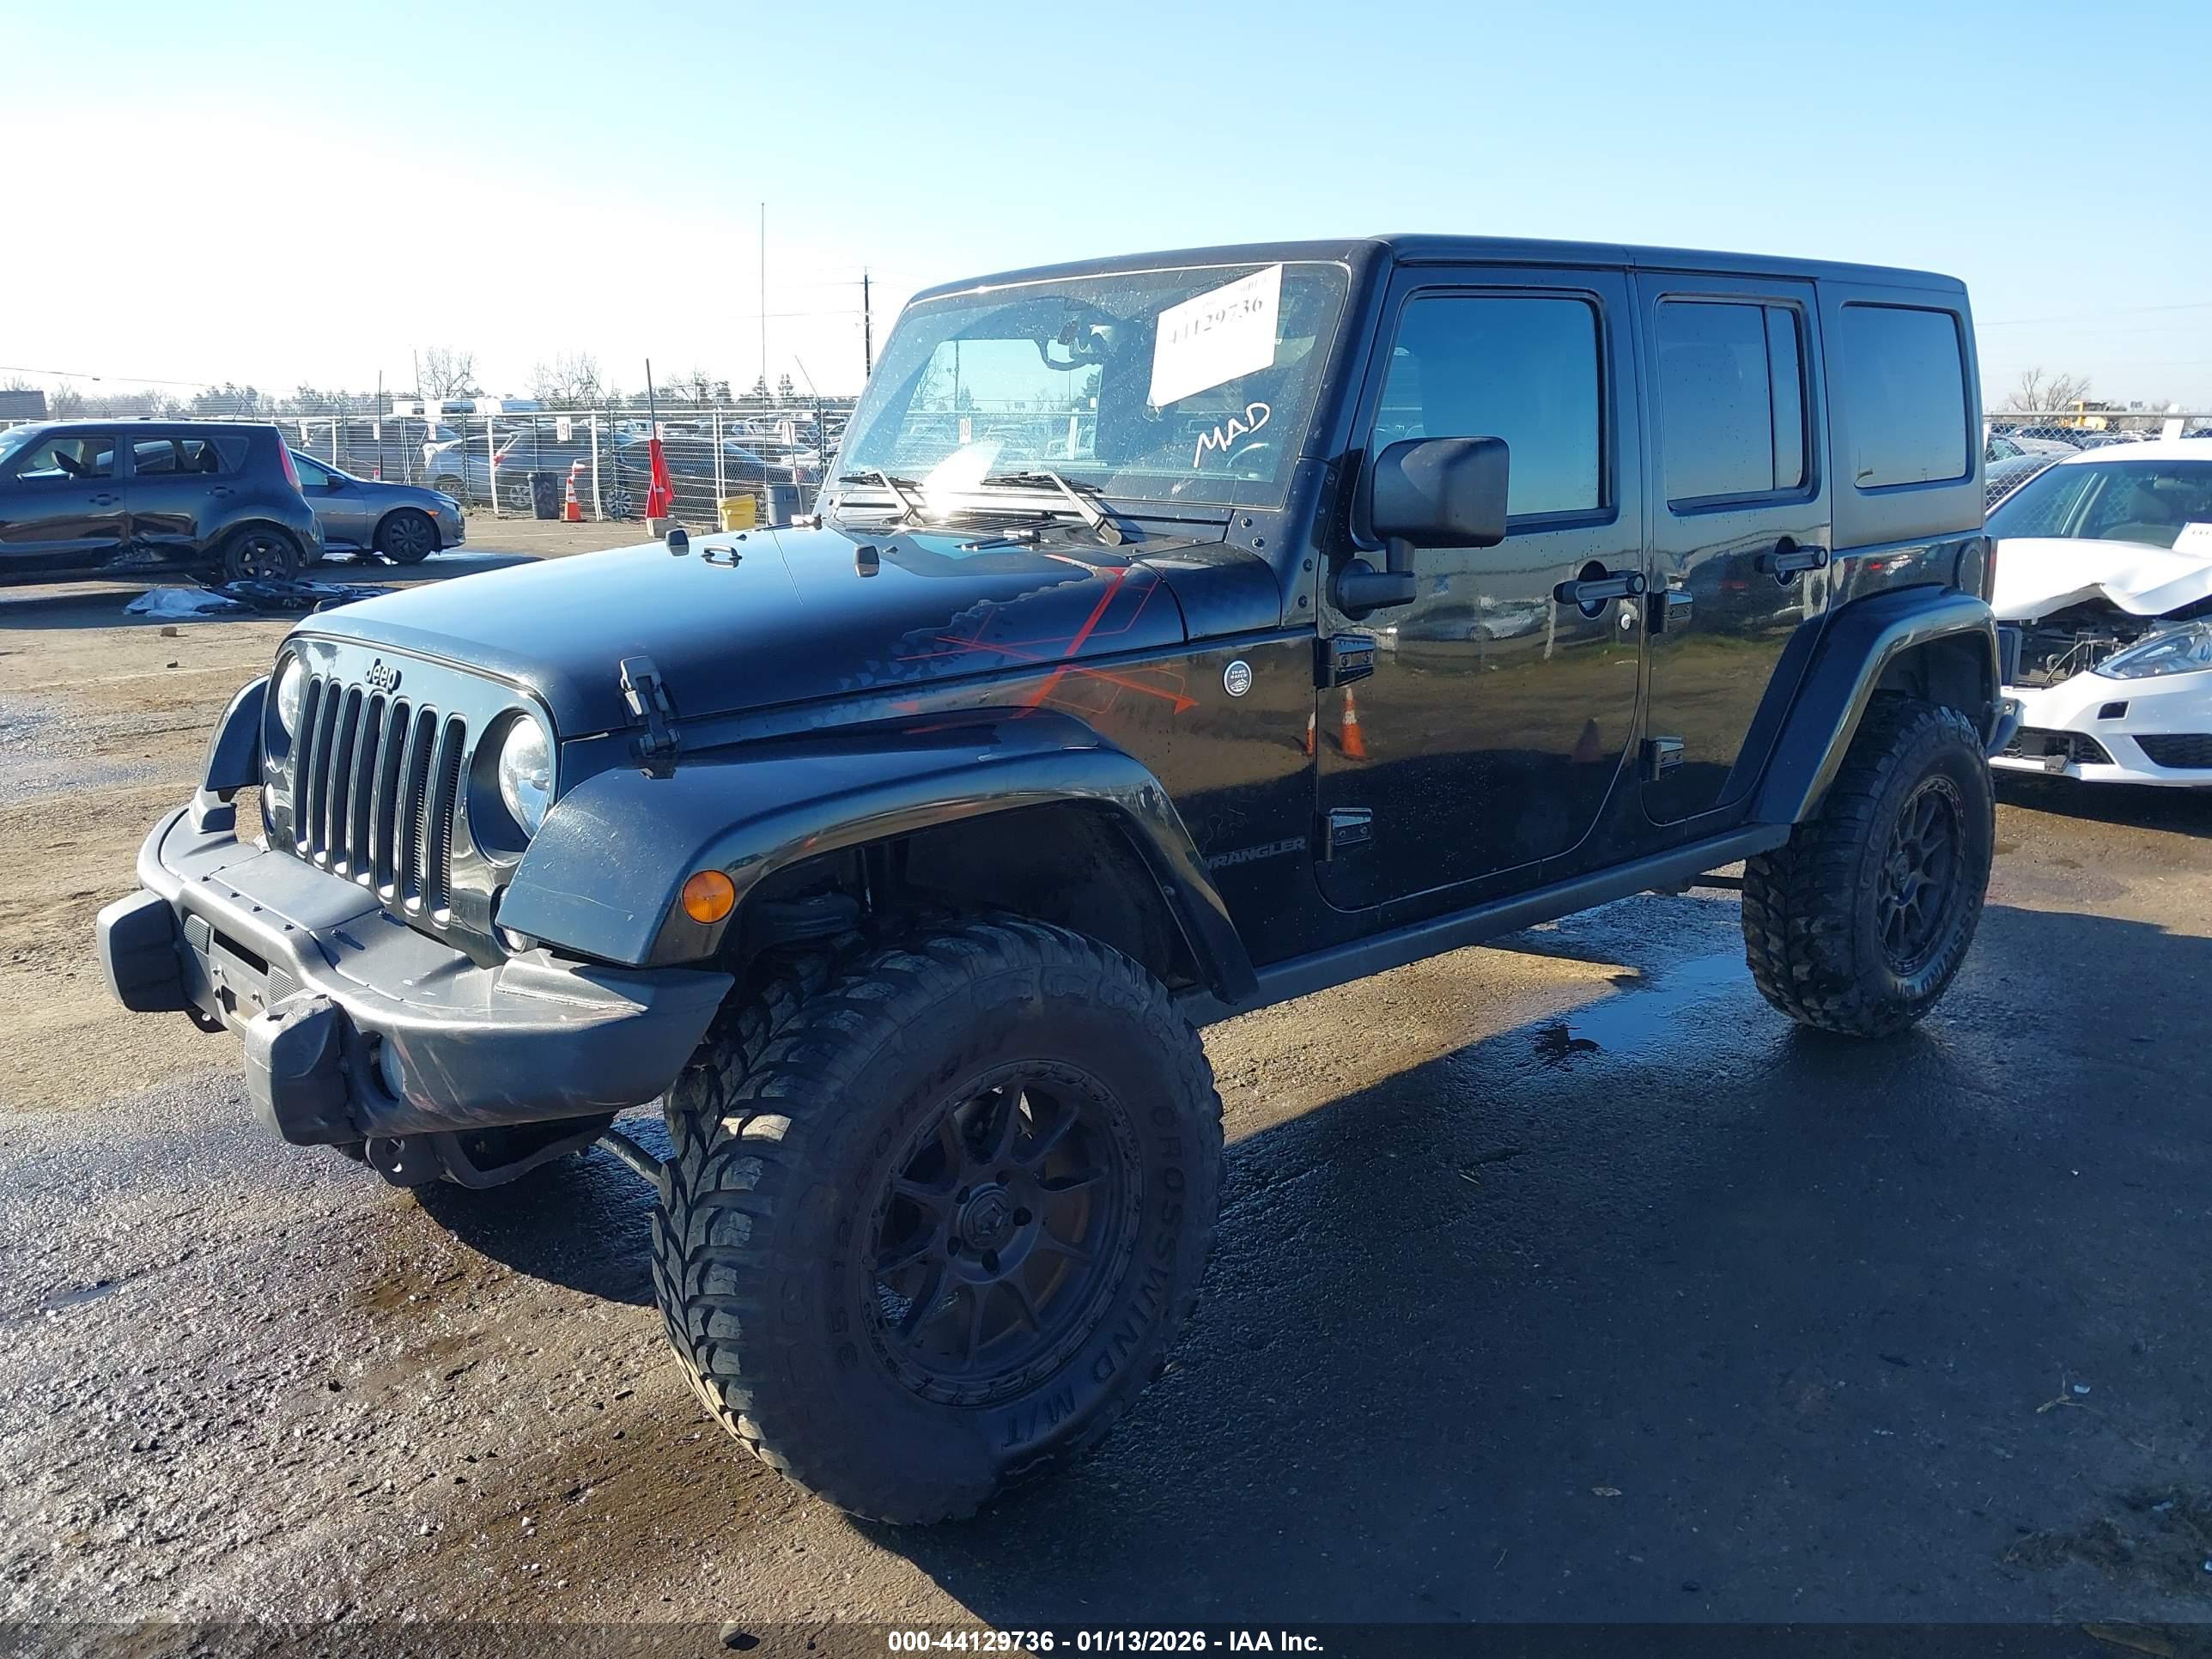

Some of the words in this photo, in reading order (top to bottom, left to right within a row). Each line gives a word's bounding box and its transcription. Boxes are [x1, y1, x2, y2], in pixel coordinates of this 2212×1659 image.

[559, 422, 568, 436] 15
[1194, 402, 1271, 468] MAD
[364, 657, 403, 696] Jeep
[1086, 1103, 1188, 1387] CROSSWIND
[1000, 1384, 1079, 1452] M/T
